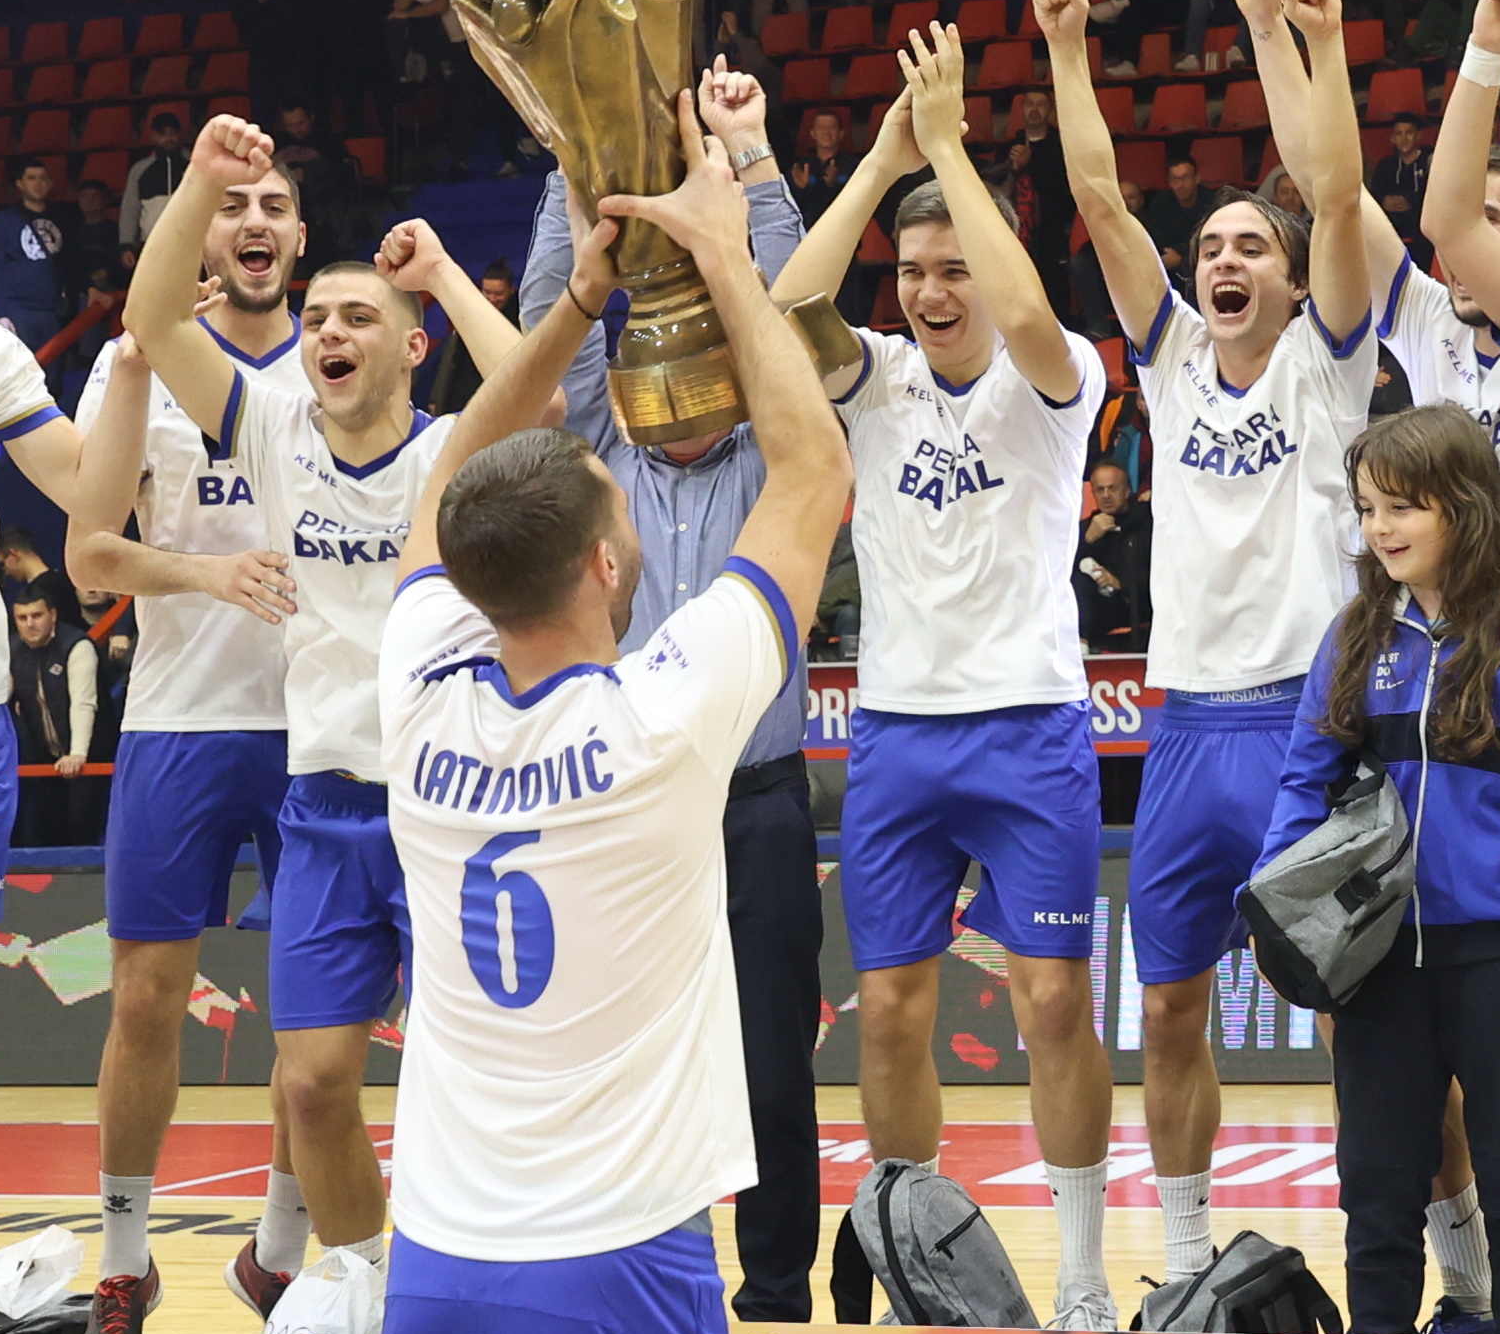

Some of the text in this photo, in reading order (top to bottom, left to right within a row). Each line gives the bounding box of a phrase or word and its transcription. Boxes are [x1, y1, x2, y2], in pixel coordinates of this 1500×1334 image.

[1183, 359, 1220, 409] KELME
[1441, 338, 1477, 385] KELME
[294, 453, 338, 488] KEME
[1179, 429, 1298, 477] BAKAL
[1376, 667, 1391, 677] DO
[459, 829, 555, 1009] 6
[1033, 910, 1092, 926] KELME
